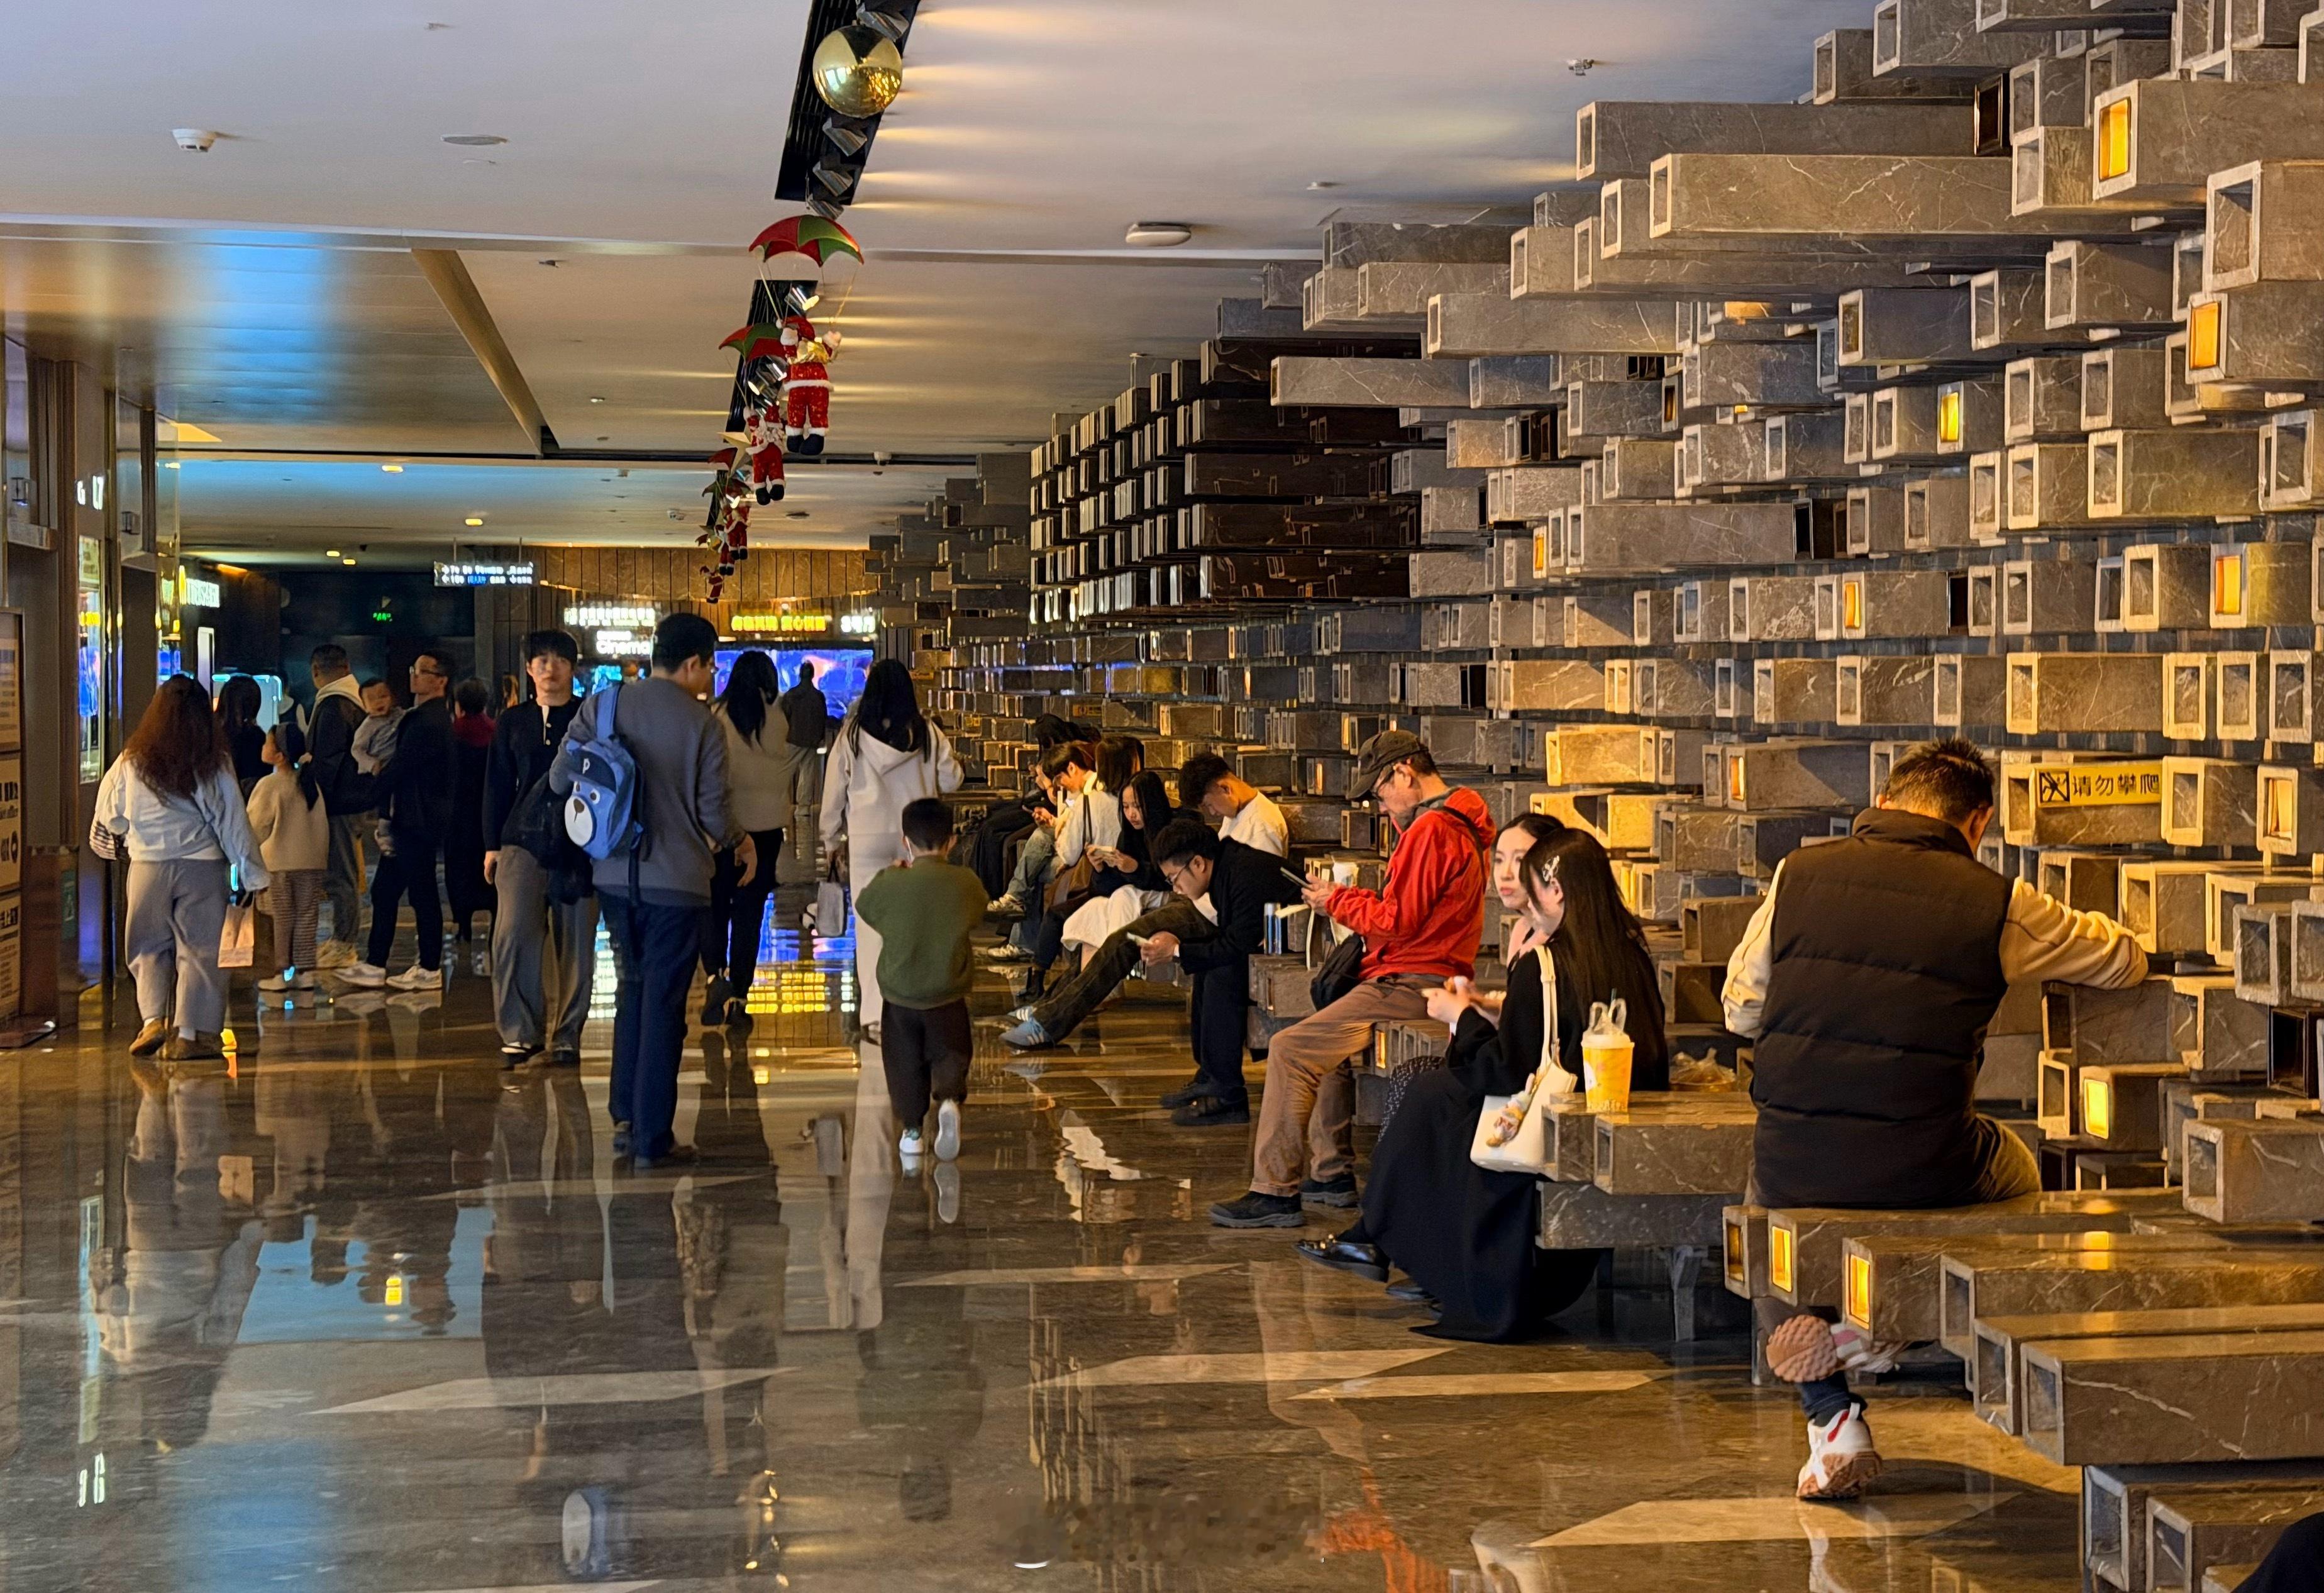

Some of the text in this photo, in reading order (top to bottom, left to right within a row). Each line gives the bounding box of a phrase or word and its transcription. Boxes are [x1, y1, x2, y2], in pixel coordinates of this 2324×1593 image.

[596, 640, 651, 655] Cinema
[2072, 773, 2159, 797] 请勿攀爬
